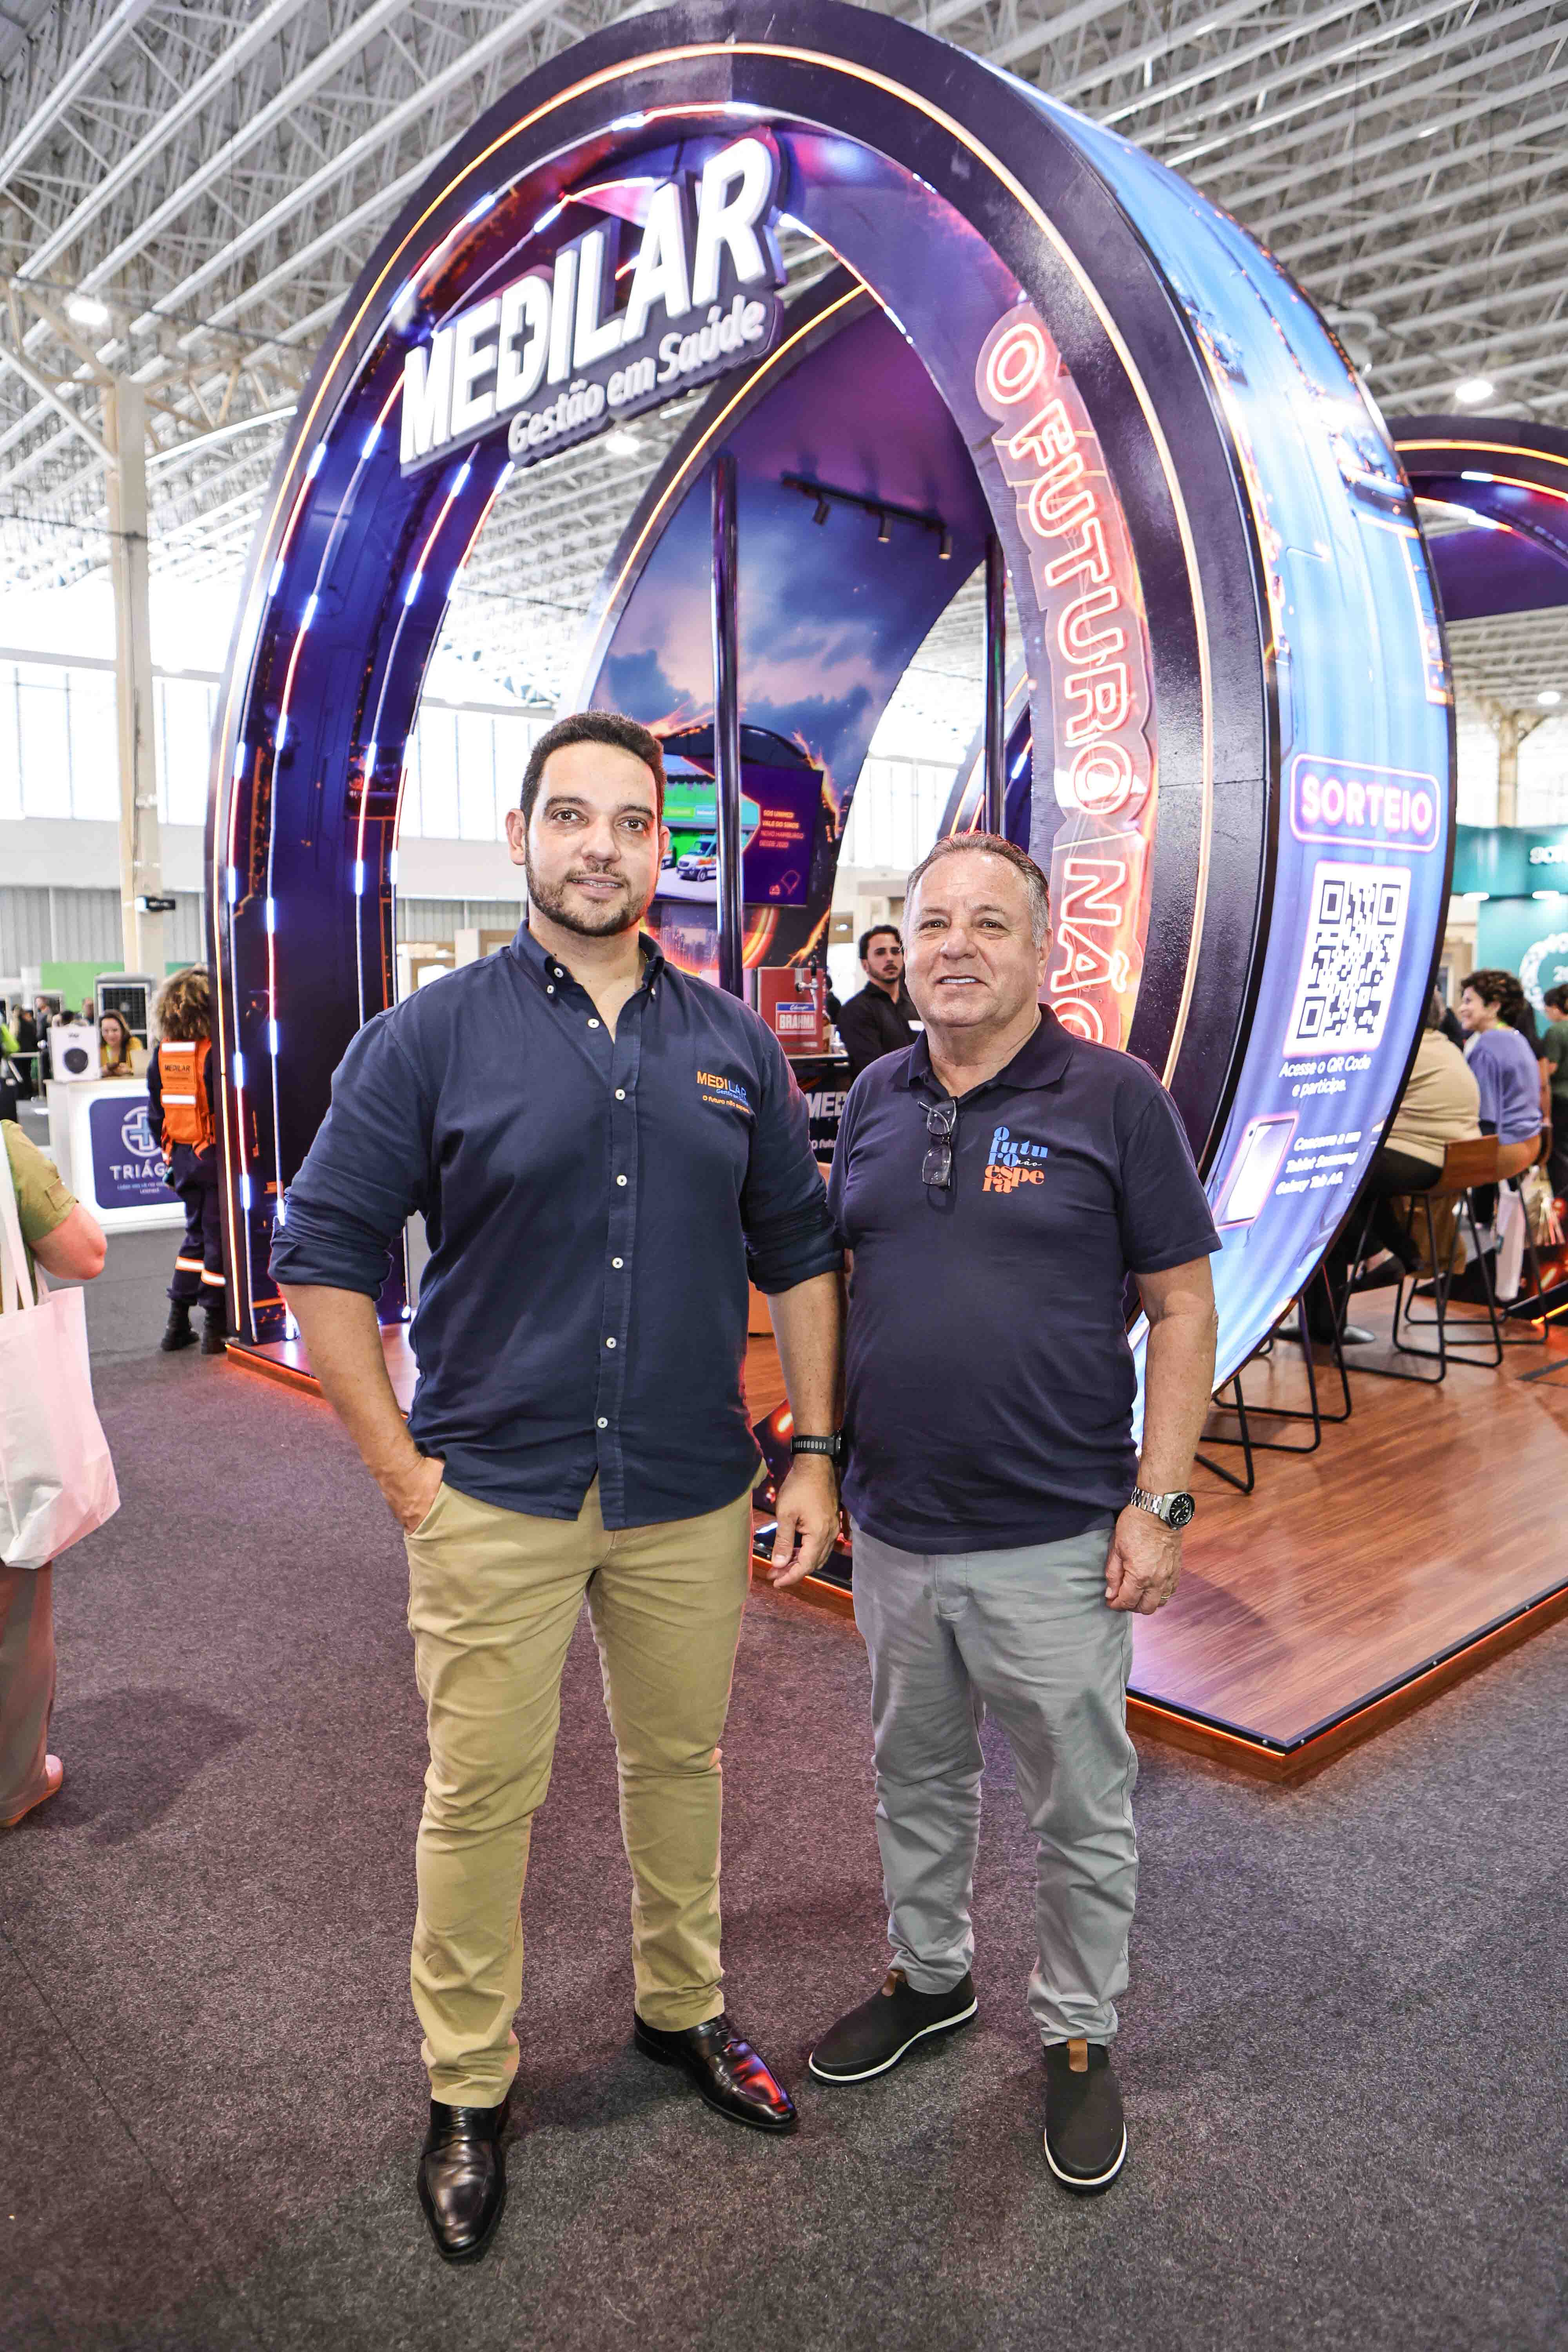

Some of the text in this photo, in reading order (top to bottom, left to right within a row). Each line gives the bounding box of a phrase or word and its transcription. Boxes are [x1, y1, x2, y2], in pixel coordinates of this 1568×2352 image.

[400, 137, 772, 466] MEDILAR
[508, 294, 766, 454] Gestão em Saúde
[986, 323, 1045, 405] O
[1008, 398, 1133, 815] FUTURO
[1301, 775, 1434, 835] SORTEIO
[1279, 1054, 1372, 1078] Acesse o QR Code
[697, 1070, 746, 1098] MEDILAR
[1292, 1084, 1300, 1097] e
[708, 1096, 725, 1104] futuro
[805, 1091, 847, 1119] MED
[109, 1158, 165, 1181] TRIÁG
